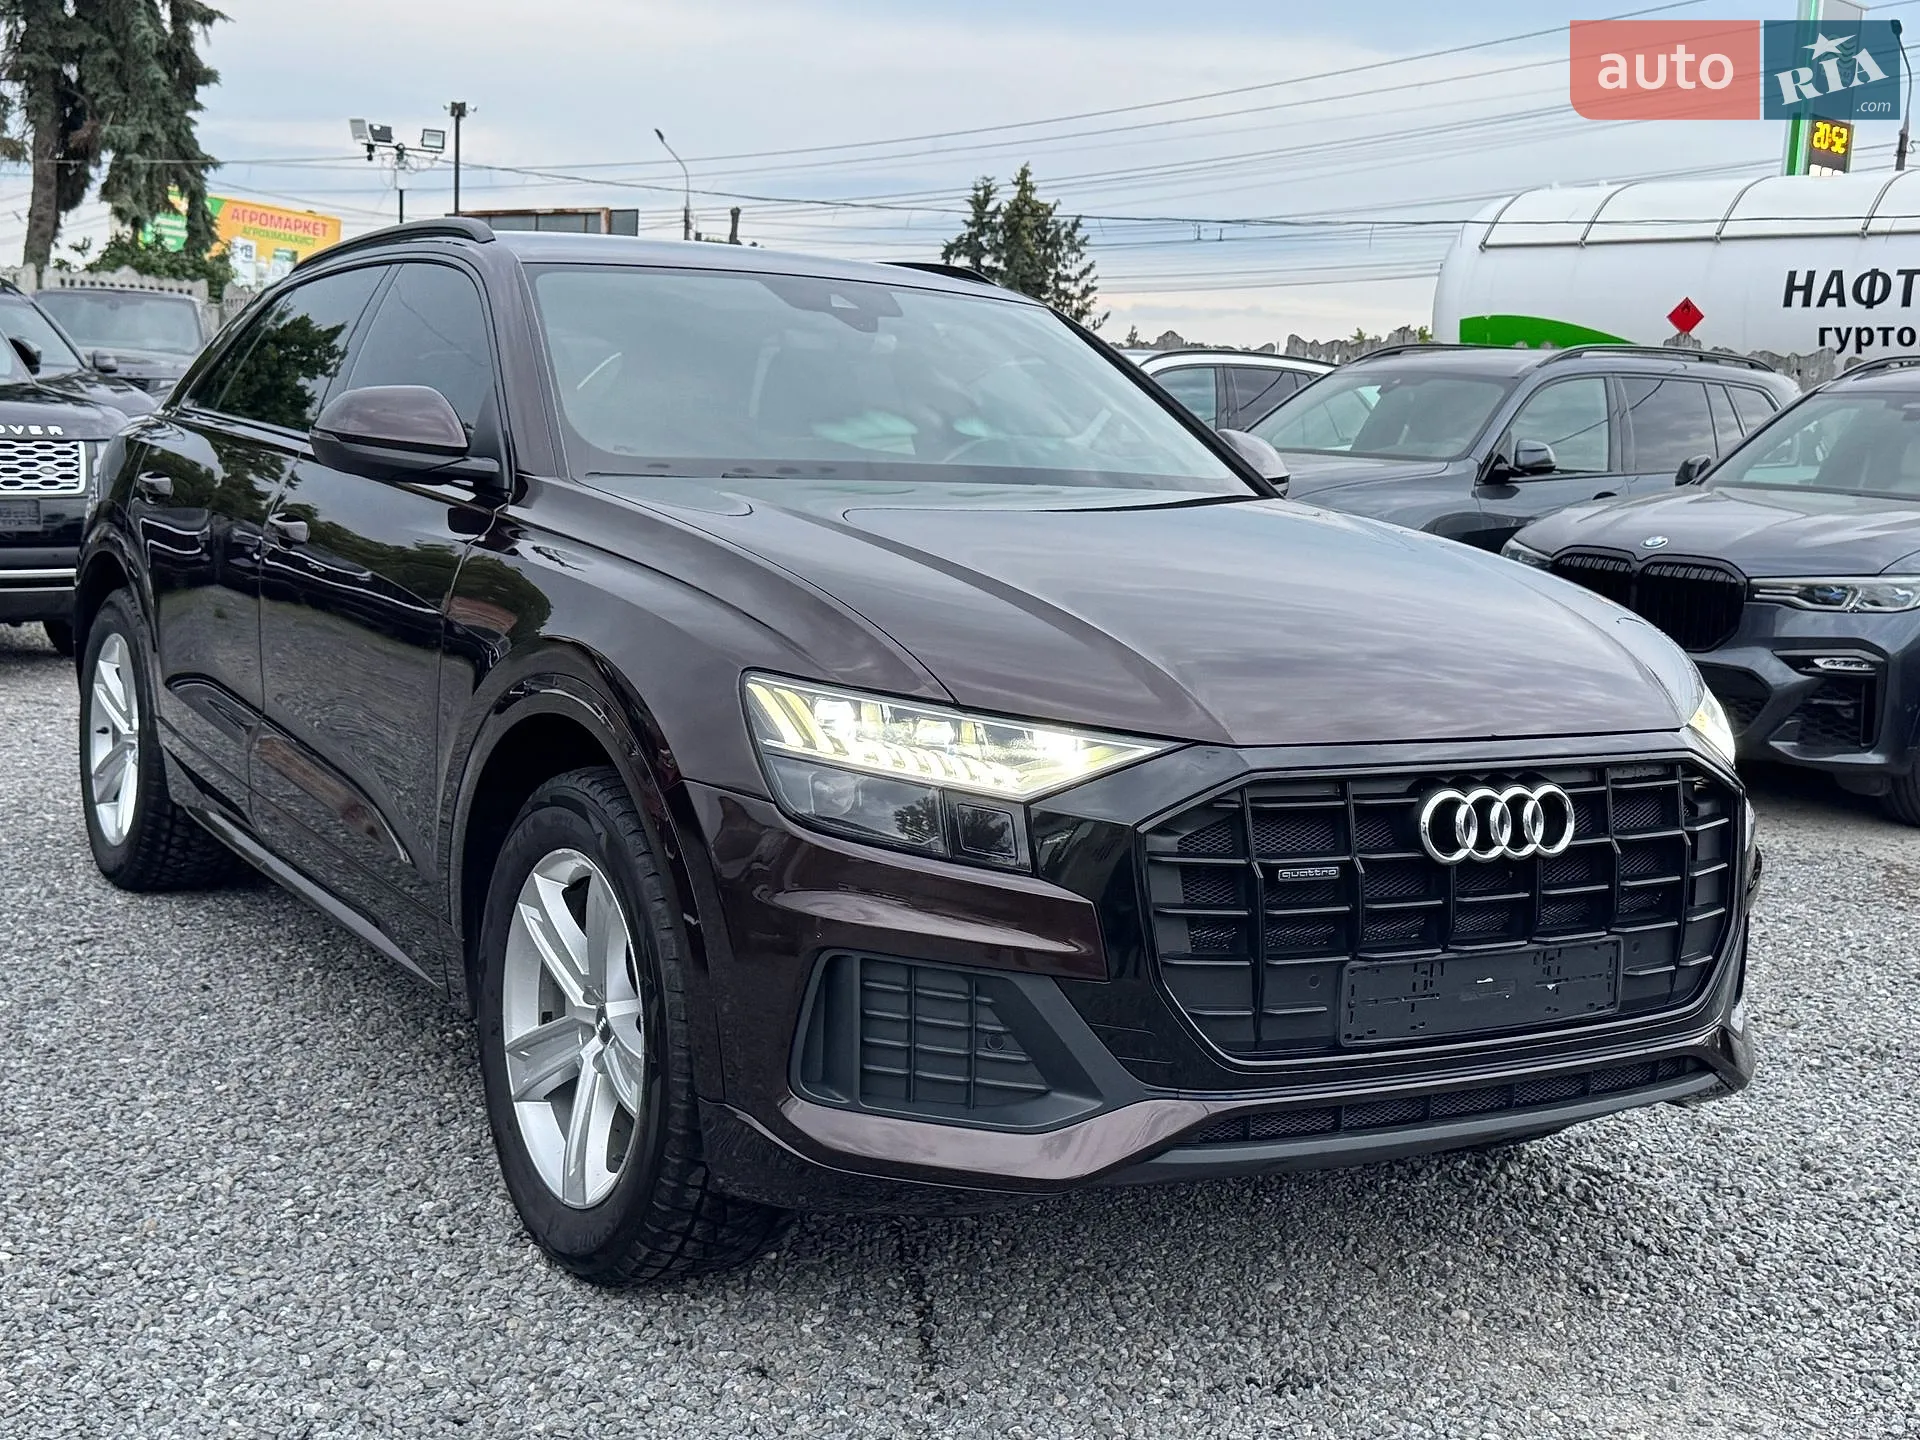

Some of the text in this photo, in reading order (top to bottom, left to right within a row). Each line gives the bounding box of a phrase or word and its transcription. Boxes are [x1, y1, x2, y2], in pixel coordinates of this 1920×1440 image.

[231, 207, 329, 238] АГРОМАРКЕТ
[1818, 326, 1920, 355] гурто
[1281, 869, 1337, 879] quattro
